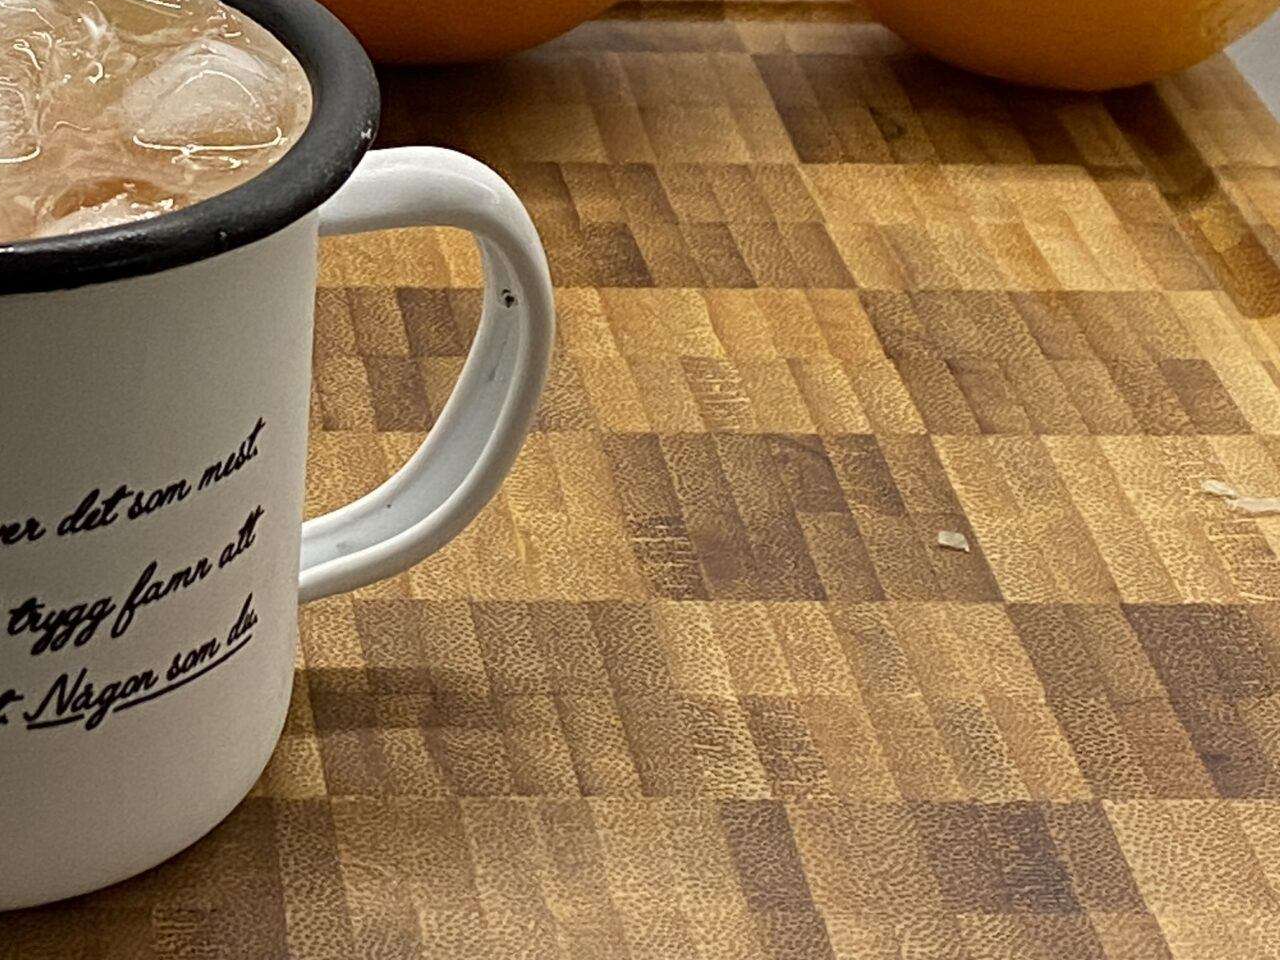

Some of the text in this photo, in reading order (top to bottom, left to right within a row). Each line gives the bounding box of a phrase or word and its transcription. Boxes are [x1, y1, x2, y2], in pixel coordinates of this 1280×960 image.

[56, 484, 135, 537] det
[126, 478, 192, 521] som
[6, 596, 117, 657] trygg
[110, 557, 213, 639] famn
[217, 504, 266, 570] att
[22, 667, 159, 732] Någon
[165, 637, 222, 682] som
